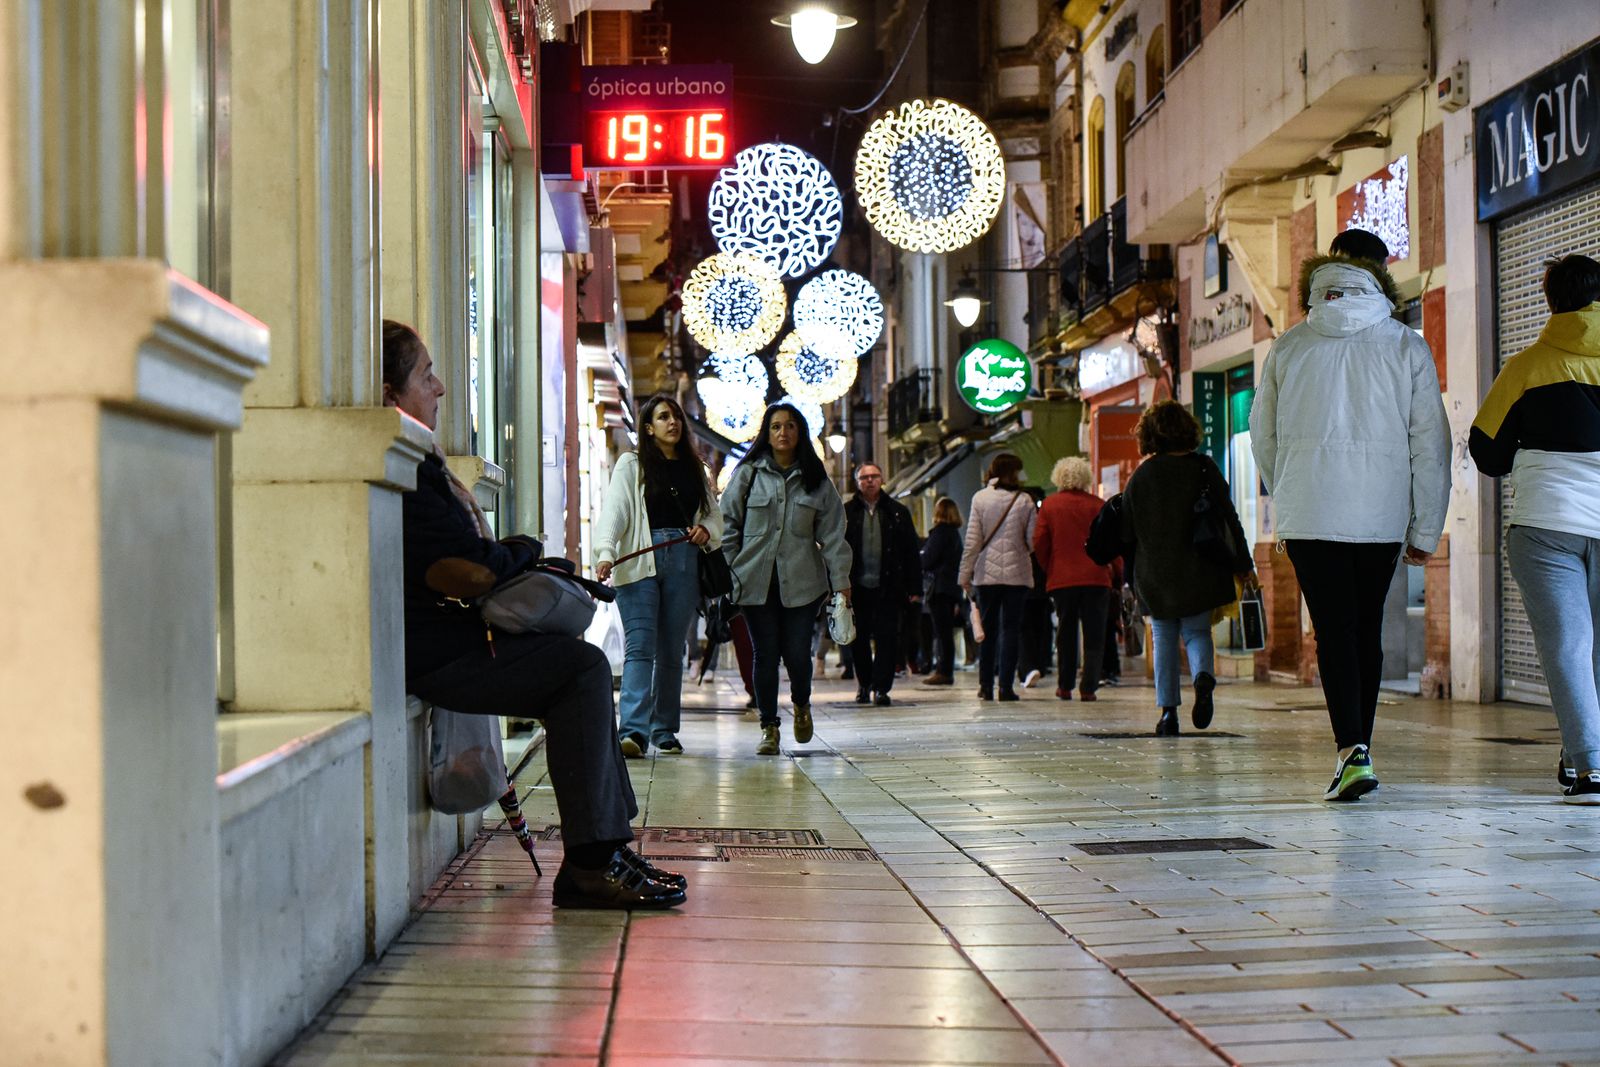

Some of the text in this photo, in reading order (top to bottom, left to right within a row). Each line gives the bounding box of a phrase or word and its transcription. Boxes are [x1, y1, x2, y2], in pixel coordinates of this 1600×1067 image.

[588, 77, 725, 100] óptica urbano
[608, 113, 725, 161] 19:16
[1488, 72, 1591, 194] MAGIC
